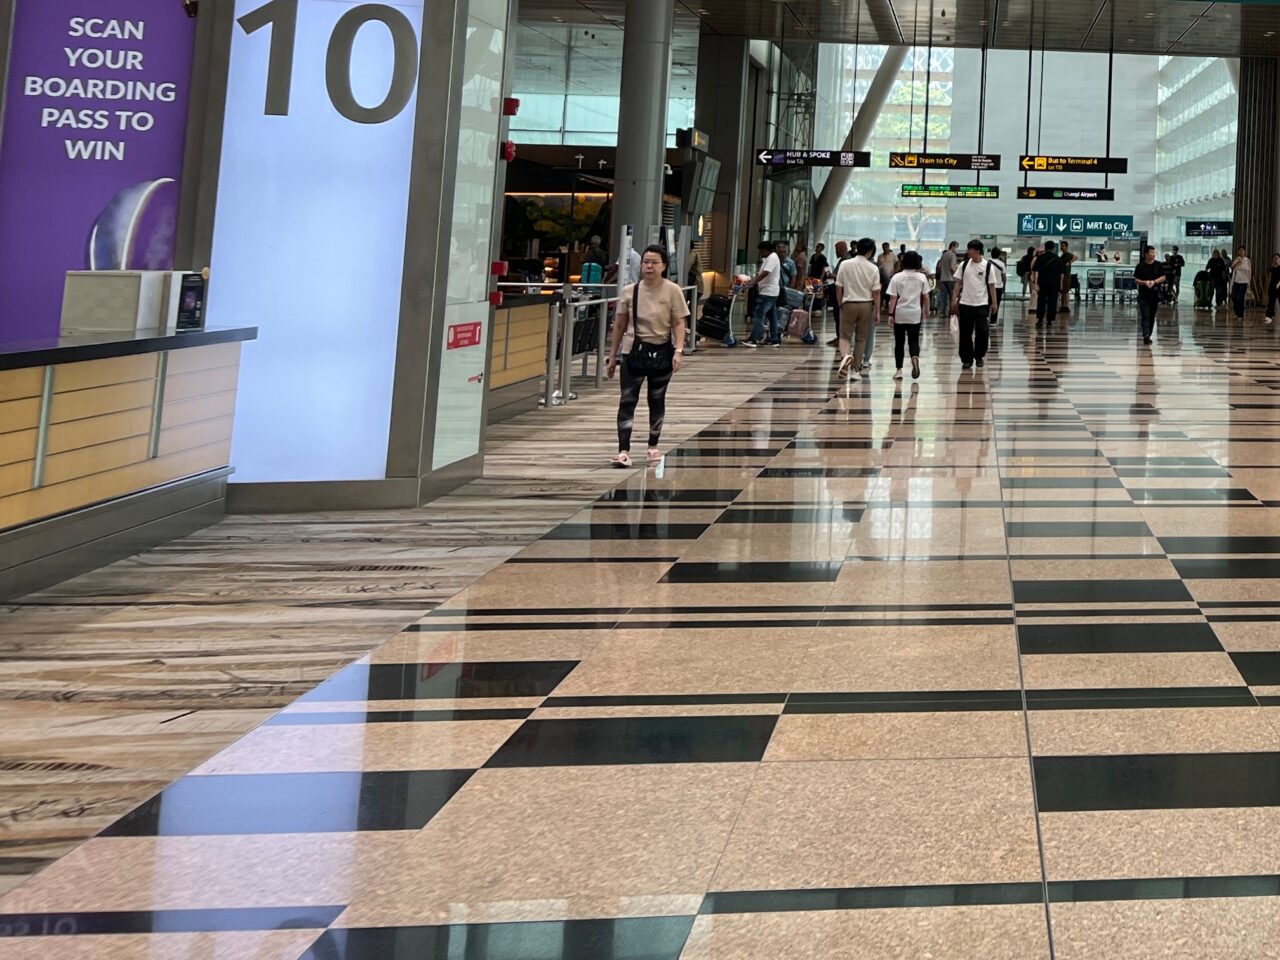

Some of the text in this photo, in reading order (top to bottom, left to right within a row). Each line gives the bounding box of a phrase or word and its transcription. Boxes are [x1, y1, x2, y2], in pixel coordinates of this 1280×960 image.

[67, 16, 145, 41] SCAN
[64, 47, 144, 71] YOUR
[23, 75, 177, 103] BOARDING
[40, 107, 154, 133] PASS TO
[65, 138, 126, 162] WIN
[809, 151, 831, 159] SPOKE
[944, 157, 958, 166] City
[1086, 221, 1128, 231] MRT to City
